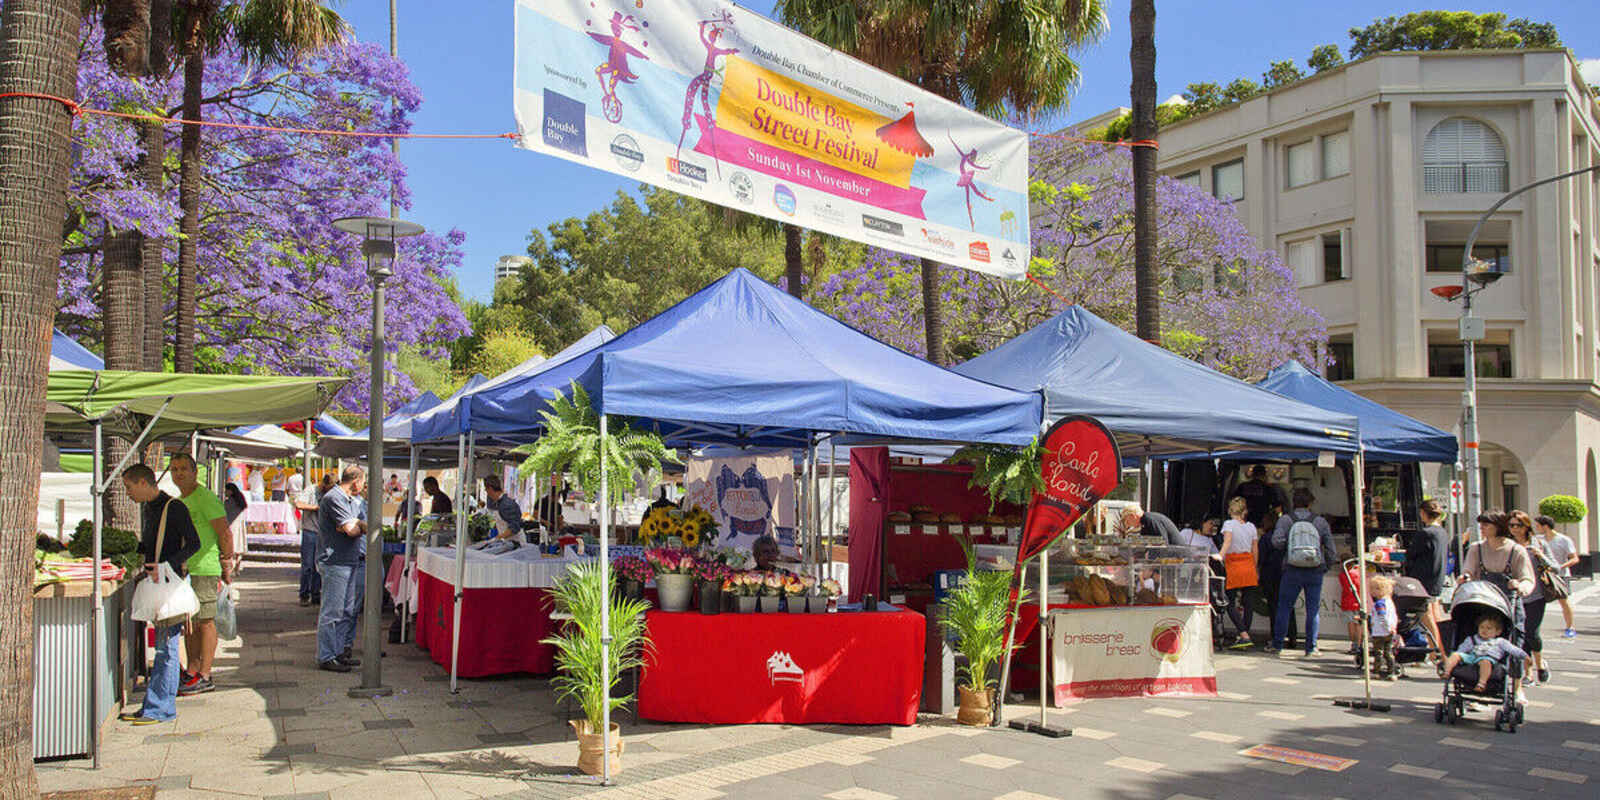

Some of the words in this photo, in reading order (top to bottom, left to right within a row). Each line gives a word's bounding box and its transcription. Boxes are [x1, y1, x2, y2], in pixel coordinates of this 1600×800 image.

[752, 45, 781, 65] Double
[781, 58, 796, 72] Bay
[797, 64, 831, 85] Chamber
[830, 79, 839, 88] of
[838, 82, 873, 102] Commerce
[873, 95, 901, 113] Presents
[547, 116, 579, 136] Double
[547, 128, 564, 144] Bay
[757, 78, 820, 121] Double
[824, 104, 855, 139] Bay
[750, 106, 809, 147] Street
[814, 129, 879, 169] Festival
[747, 147, 793, 176] Sunday
[796, 164, 812, 180] 1st
[814, 168, 872, 197] November
